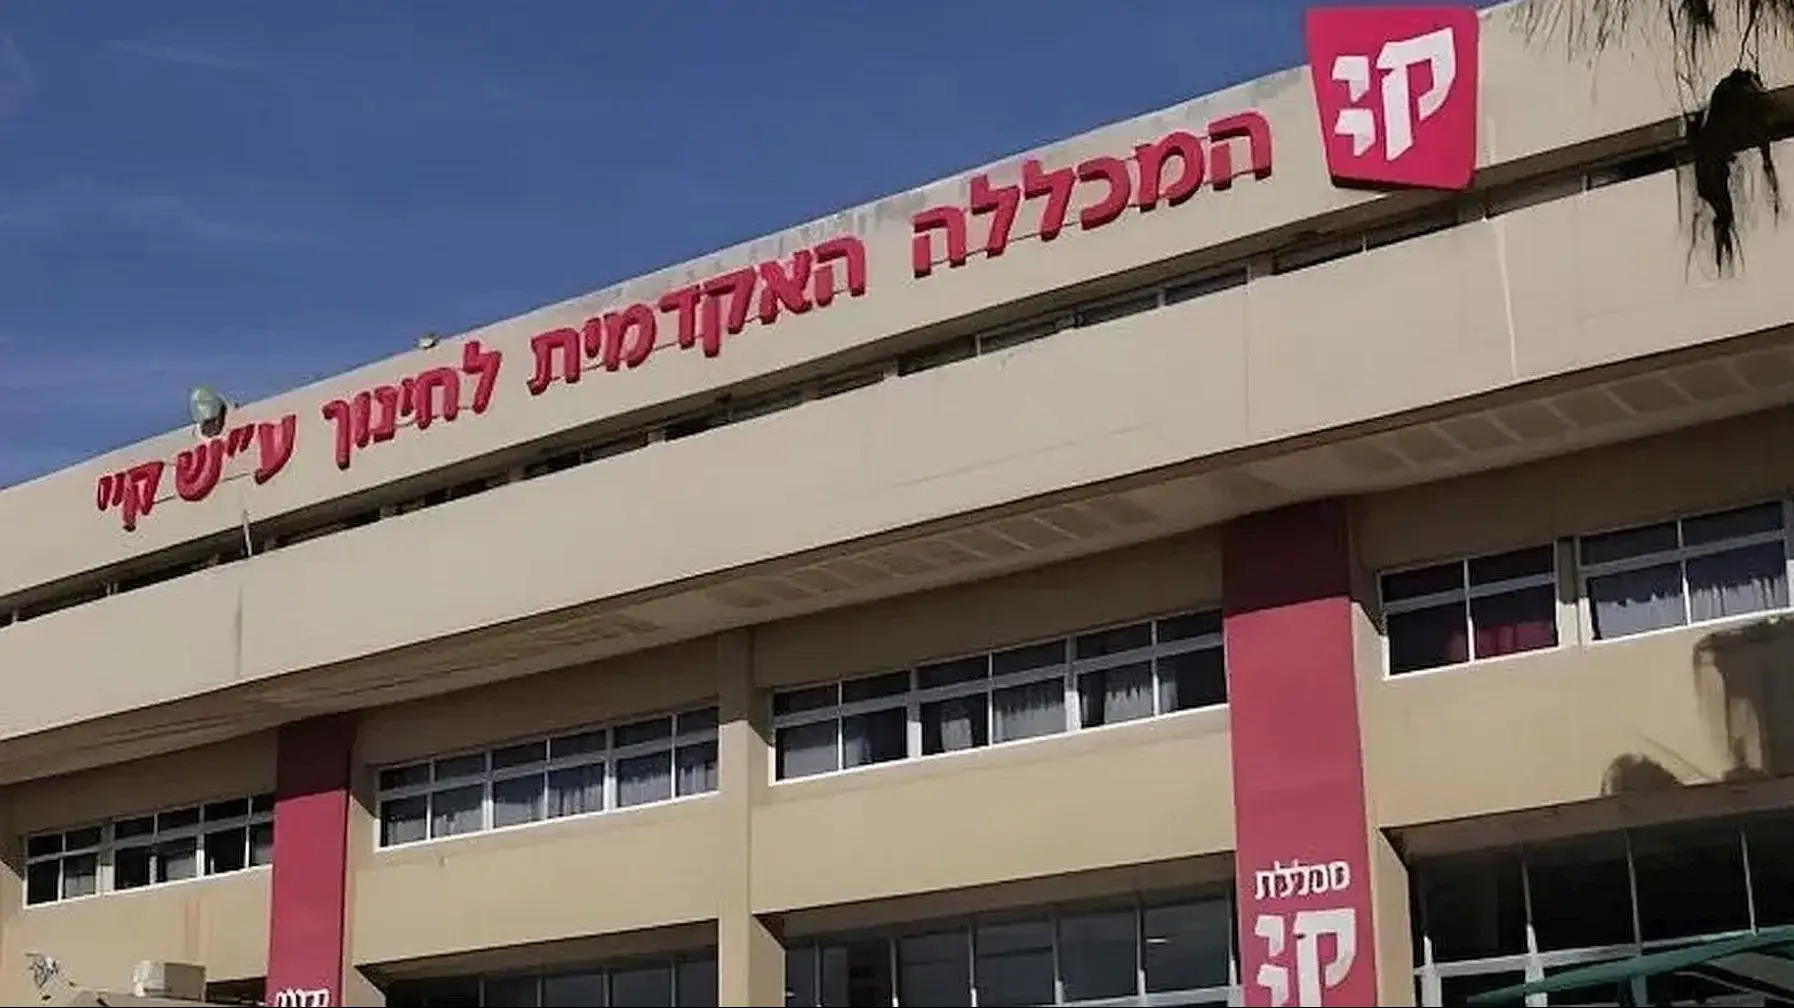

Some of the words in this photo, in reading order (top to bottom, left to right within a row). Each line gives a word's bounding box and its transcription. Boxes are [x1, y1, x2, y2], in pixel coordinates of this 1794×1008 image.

[909, 108, 1275, 277] המכללה
[529, 233, 870, 393] האקדמית
[321, 338, 504, 470] לחינוך
[96, 460, 166, 532] קיי
